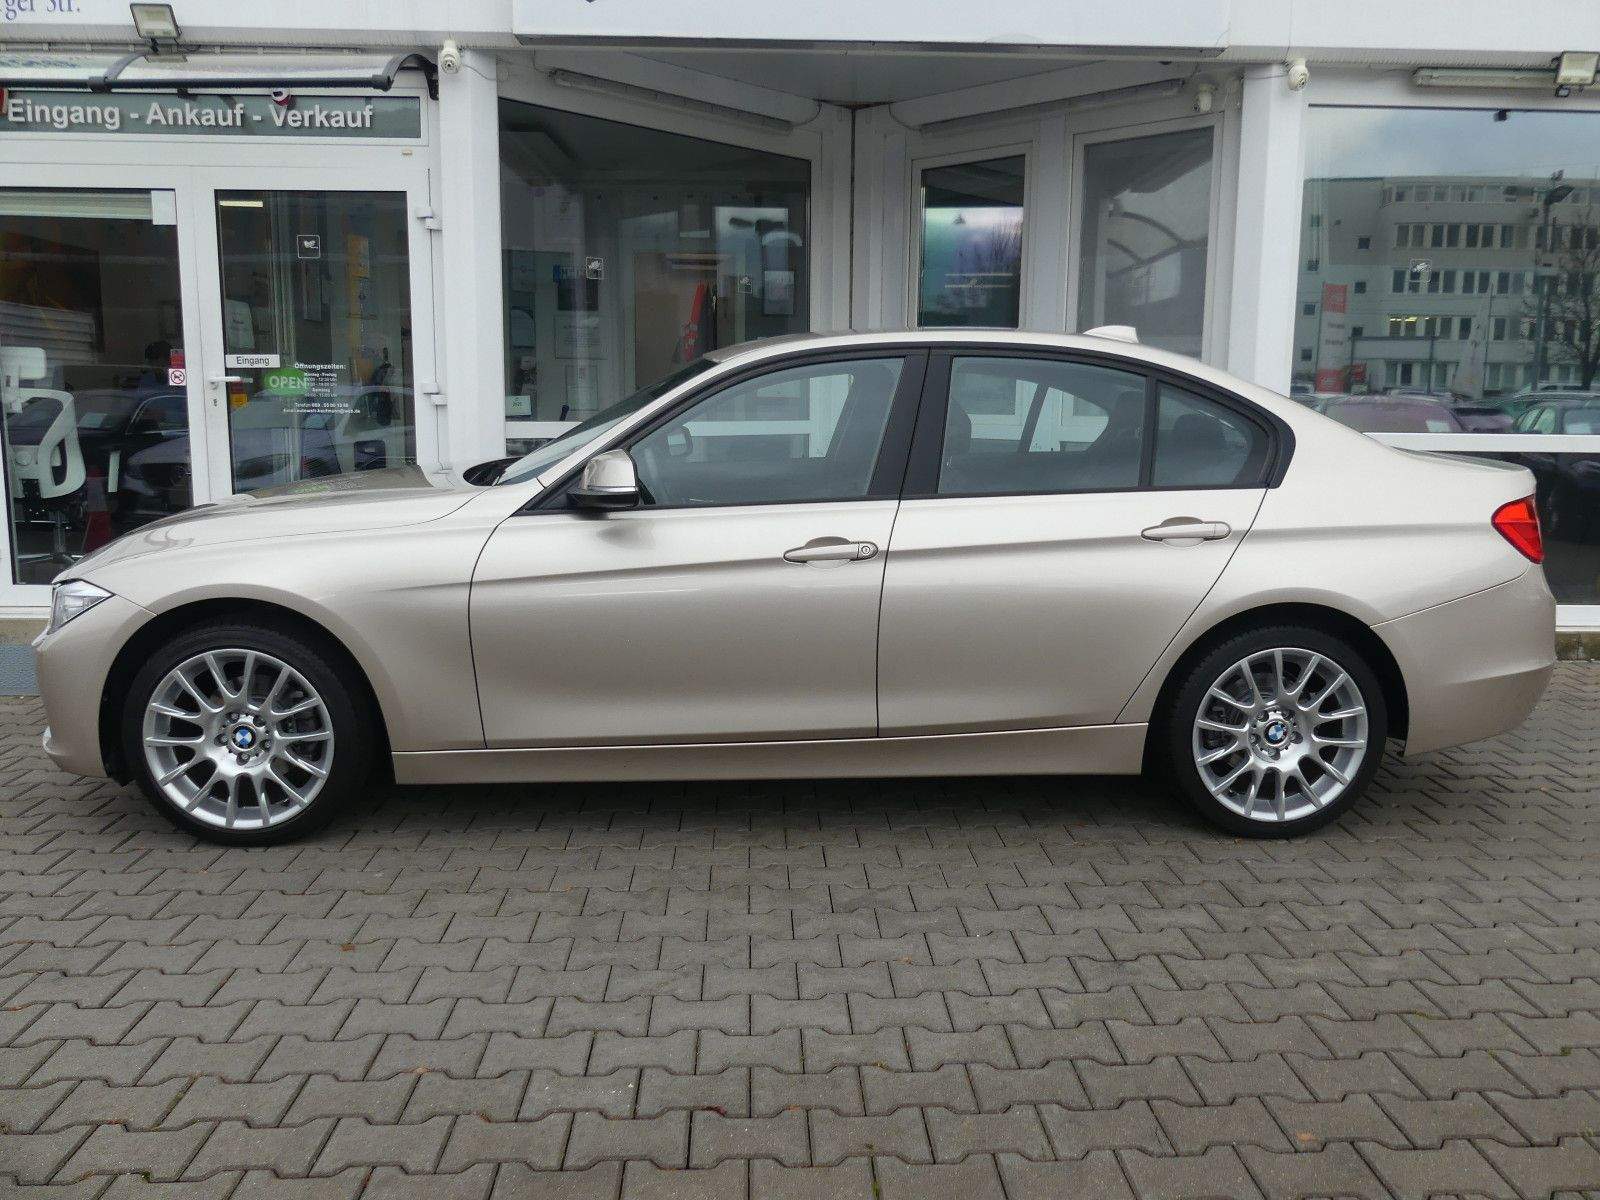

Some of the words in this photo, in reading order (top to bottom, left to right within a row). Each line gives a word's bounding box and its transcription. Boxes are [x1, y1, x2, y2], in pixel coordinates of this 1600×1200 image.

[7, 99, 121, 130] Eingang
[146, 102, 244, 128] Ankauf
[270, 103, 374, 129] Verkauf
[236, 356, 270, 366] Eingang
[269, 375, 308, 389] OPEN
